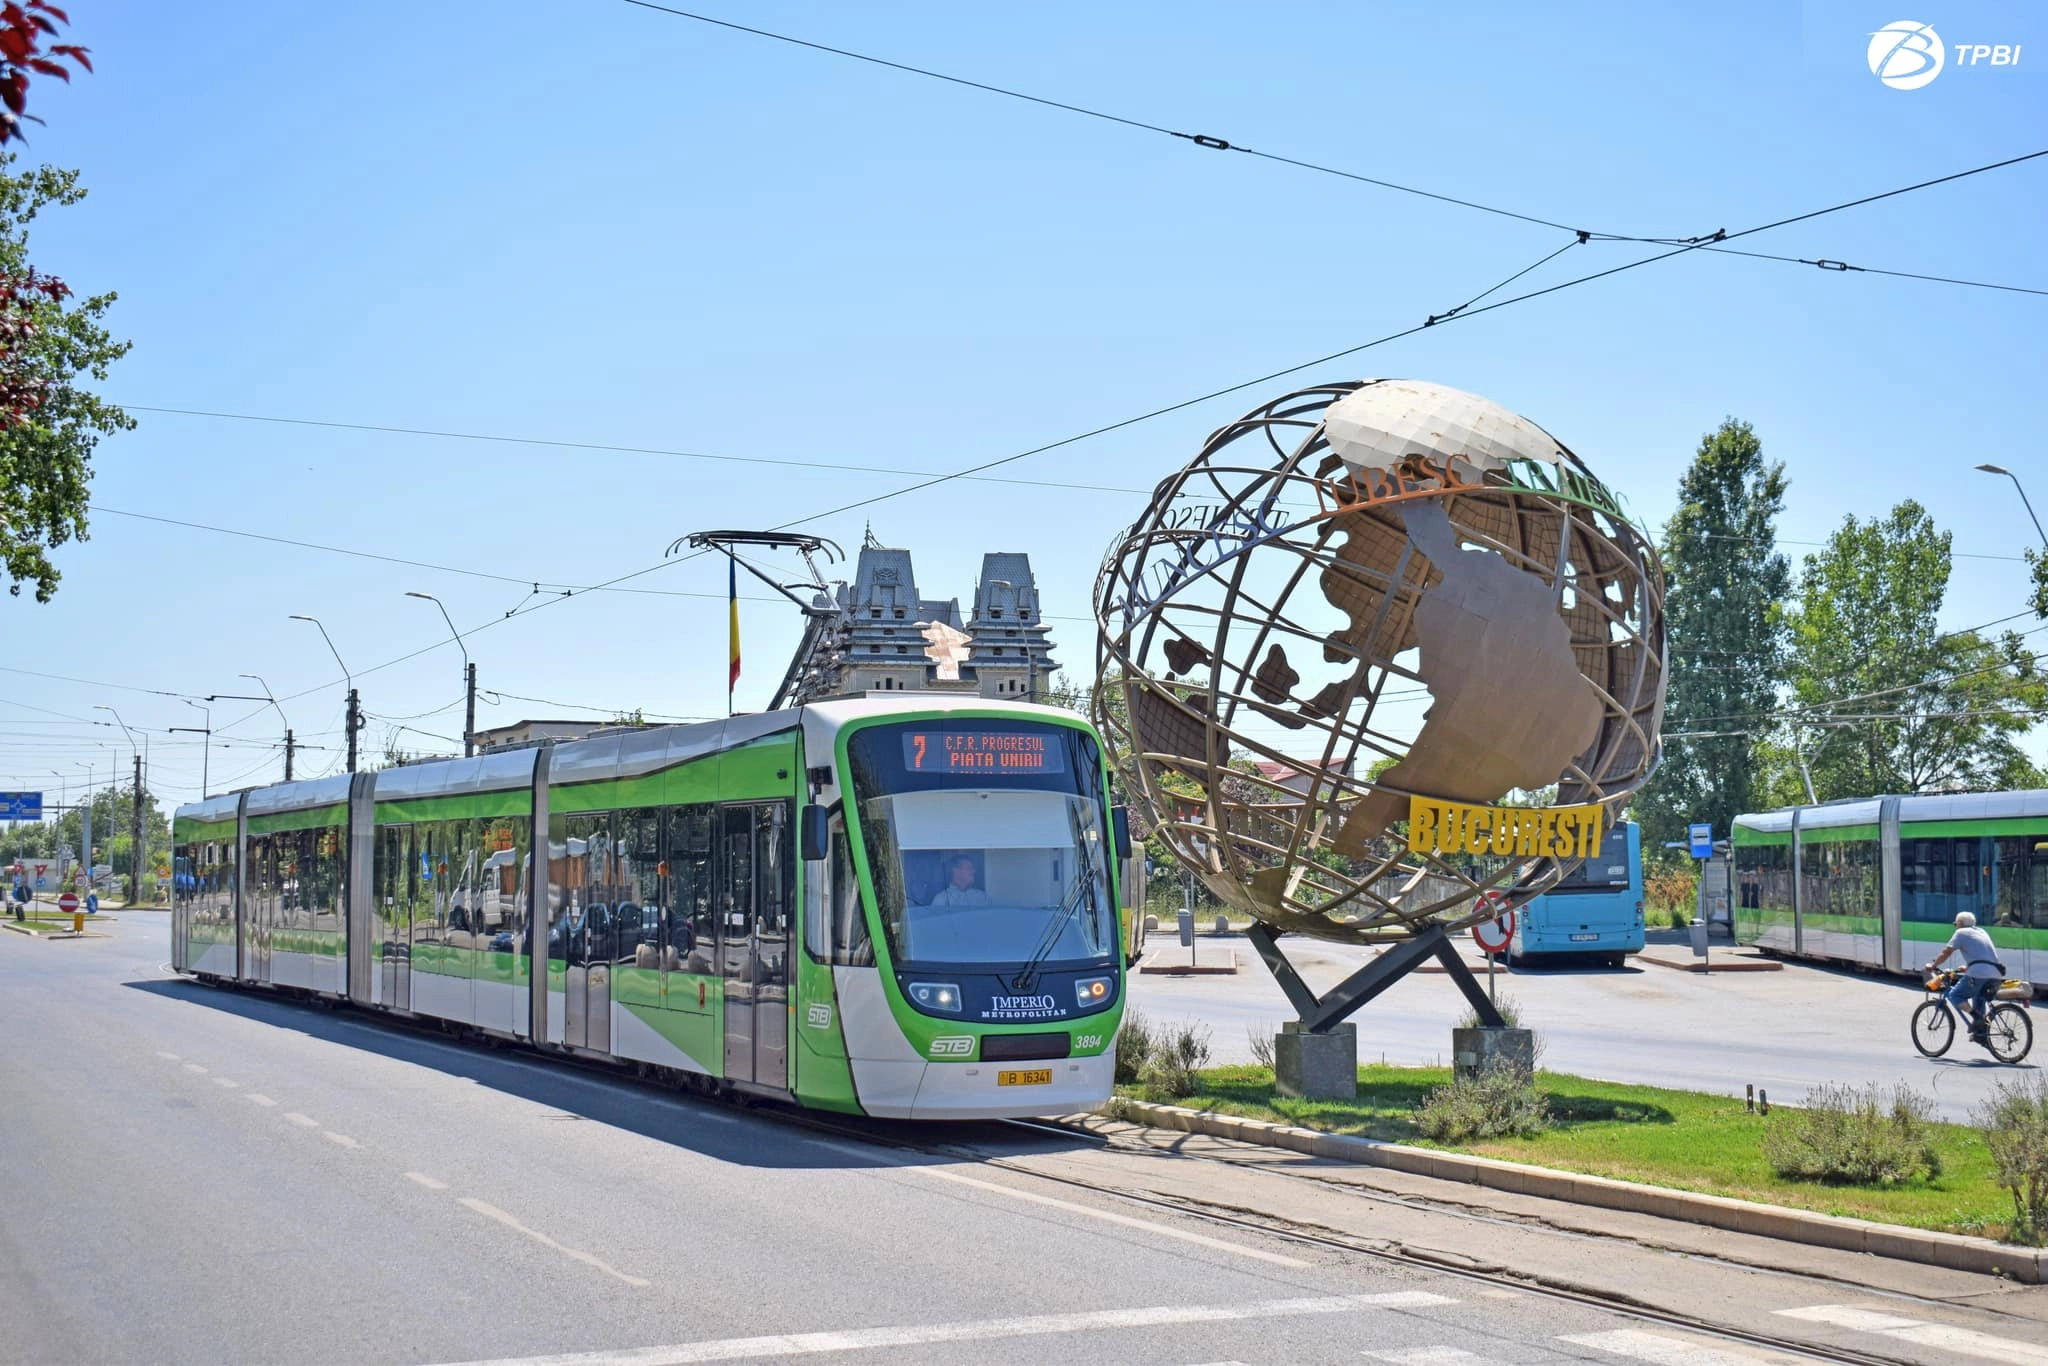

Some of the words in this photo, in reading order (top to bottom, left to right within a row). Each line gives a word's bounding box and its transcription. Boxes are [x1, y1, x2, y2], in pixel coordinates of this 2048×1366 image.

[1312, 453, 1482, 518] IUBESC
[914, 736, 926, 768] 7
[945, 736, 978, 750] C.F.R.
[982, 736, 1046, 751] PROGRESUL
[950, 752, 994, 767] PIATA
[1000, 753, 1043, 767] UNIRII
[1409, 797, 1603, 858] BUCURESTI
[992, 994, 1055, 1011] IMPERIO
[808, 1004, 832, 1029] STB
[981, 1009, 1067, 1018] METROPOLITAN
[930, 1036, 976, 1057] STB
[1075, 1035, 1102, 1049] 3894
[1008, 1074, 1017, 1085] B
[1023, 1072, 1051, 1084] 16341
